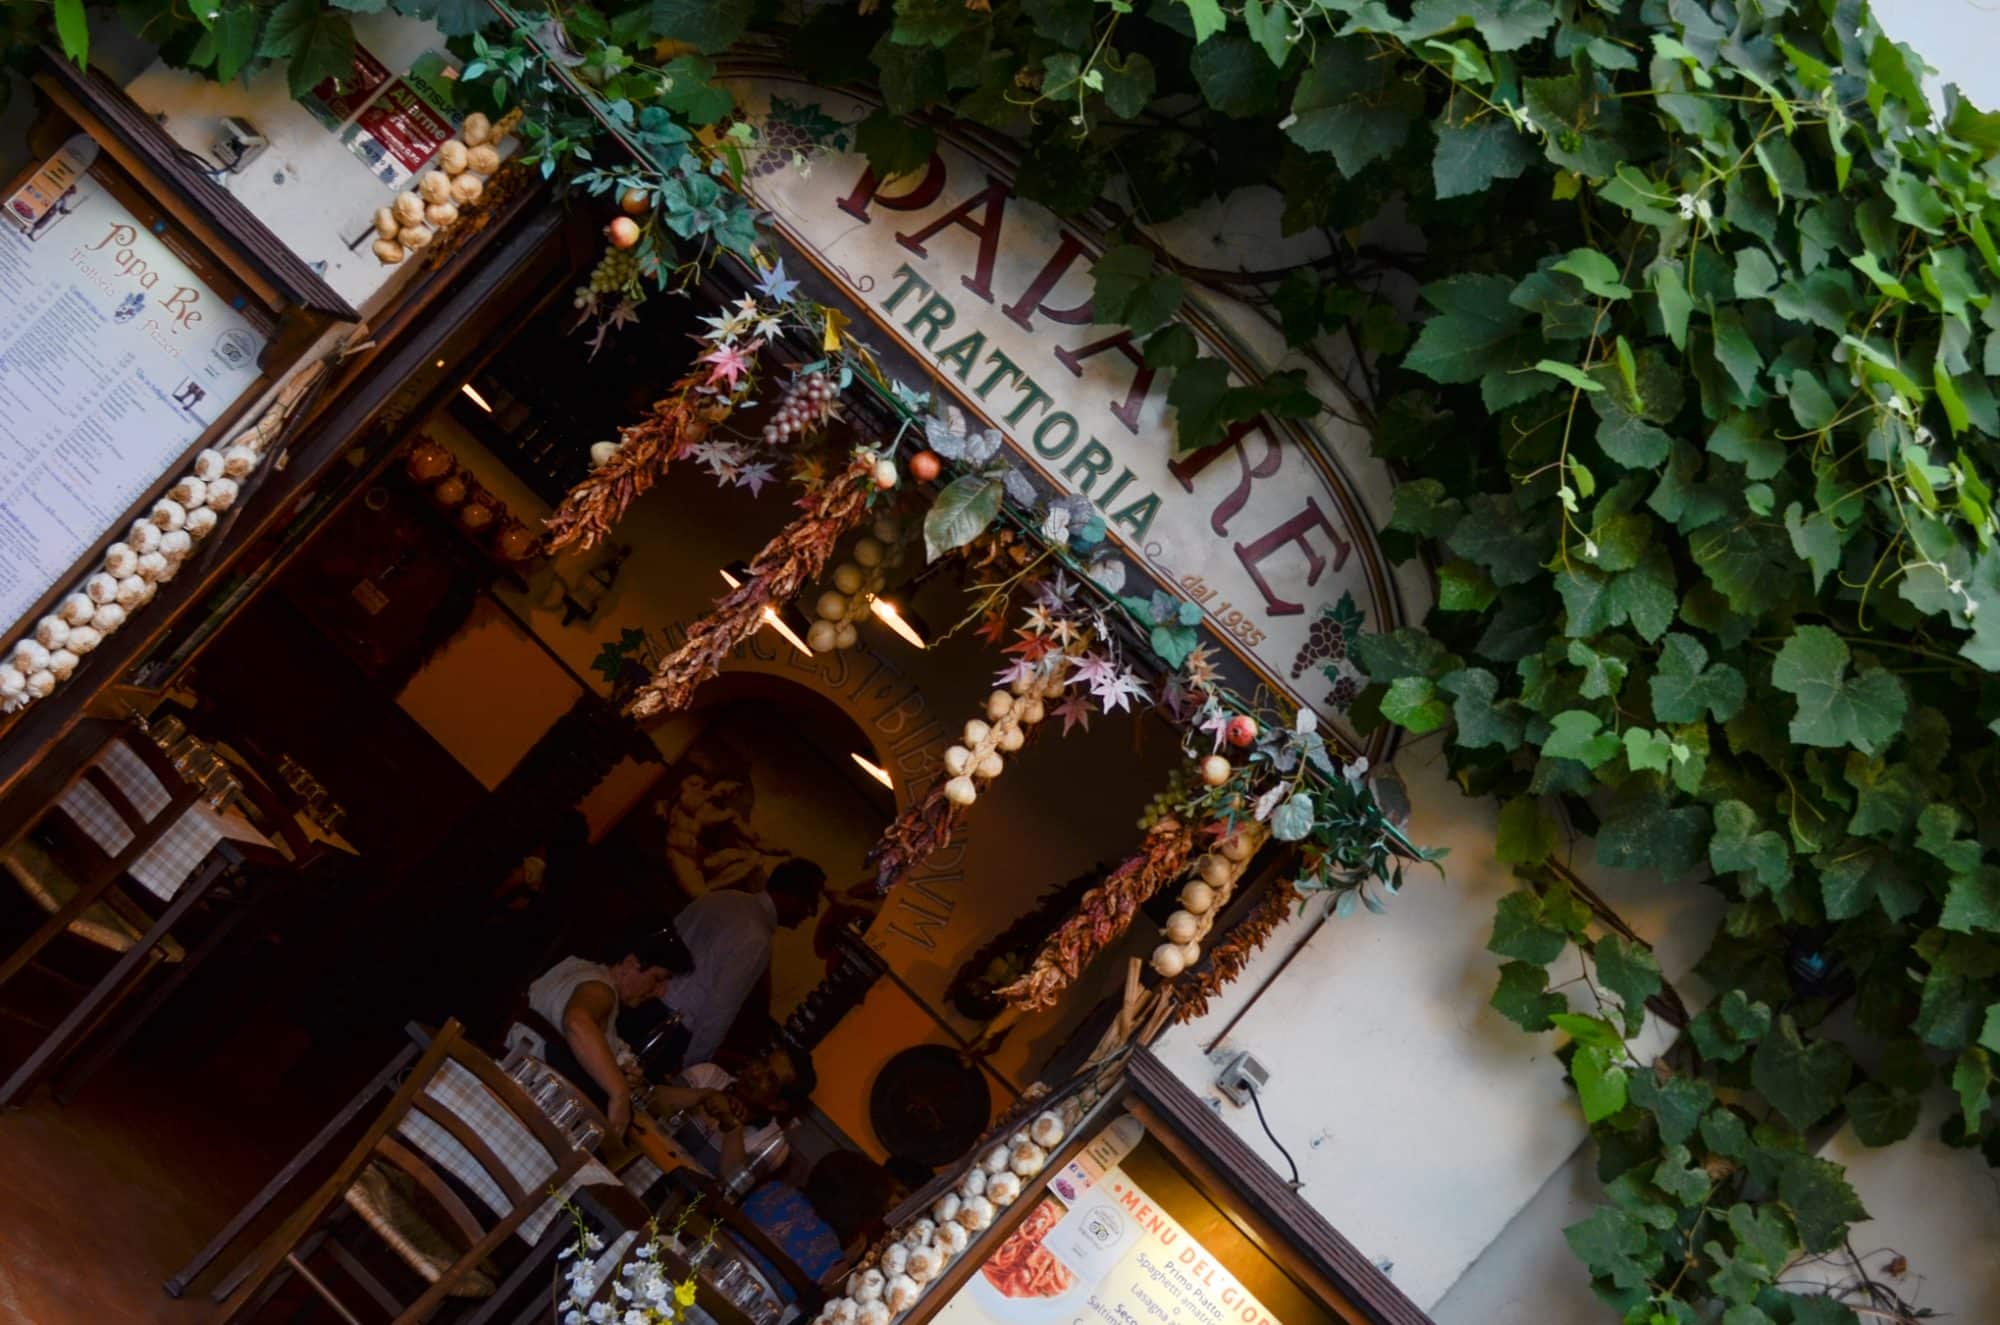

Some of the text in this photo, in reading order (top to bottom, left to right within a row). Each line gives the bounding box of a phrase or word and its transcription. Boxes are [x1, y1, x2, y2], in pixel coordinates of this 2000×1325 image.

[390, 87, 446, 140] Allarme
[84, 221, 160, 290] Papa
[157, 285, 203, 335] Re
[880, 263, 1164, 548] TRATTORIA
[1167, 412, 1352, 617] RE
[1180, 575, 1267, 647] dal 1935
[1119, 1190, 1177, 1246] MENU
[1136, 1252, 1183, 1298] Spaghetti
[1164, 1260, 1193, 1291] Primo
[1087, 1295, 1123, 1325] Saltim
[1114, 1303, 1138, 1325] Seco
